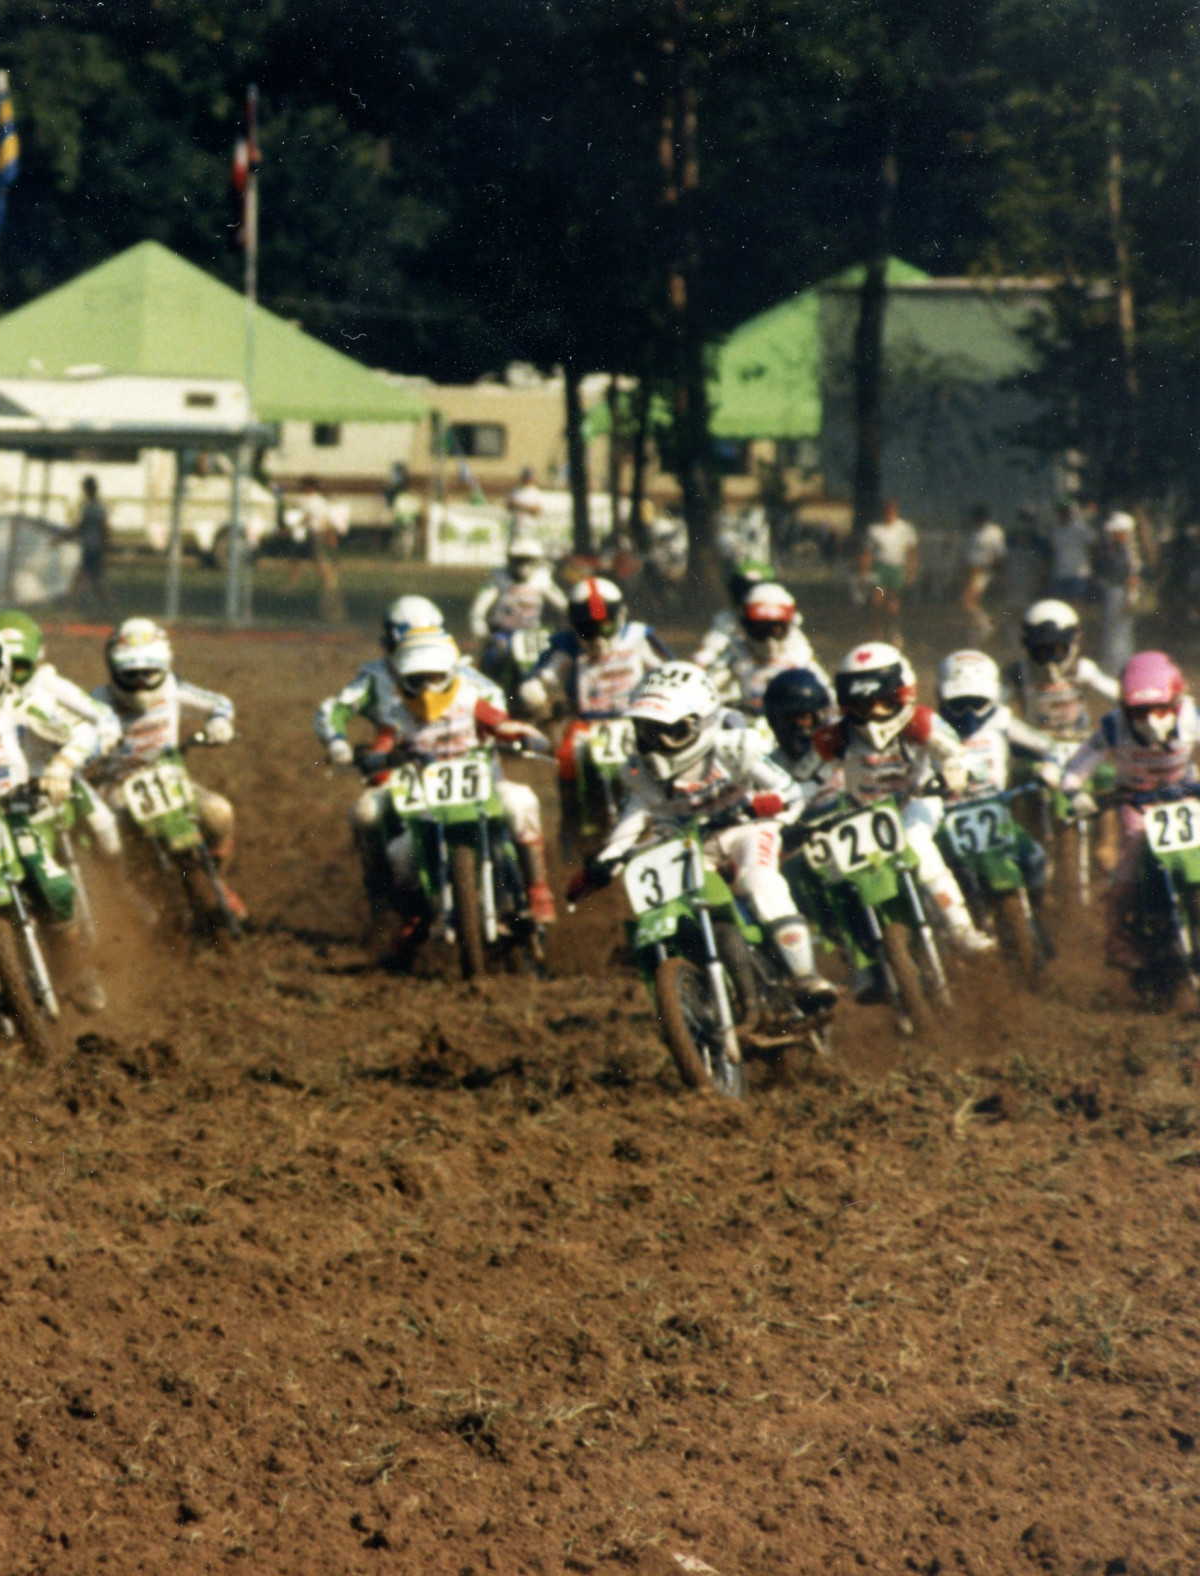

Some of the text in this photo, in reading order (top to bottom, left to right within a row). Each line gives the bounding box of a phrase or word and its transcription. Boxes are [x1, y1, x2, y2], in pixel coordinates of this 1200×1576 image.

[132, 772, 171, 814] 31
[436, 763, 481, 801] 35
[954, 810, 1007, 855] 52
[1155, 807, 1194, 847] 23
[640, 850, 693, 907] 37
